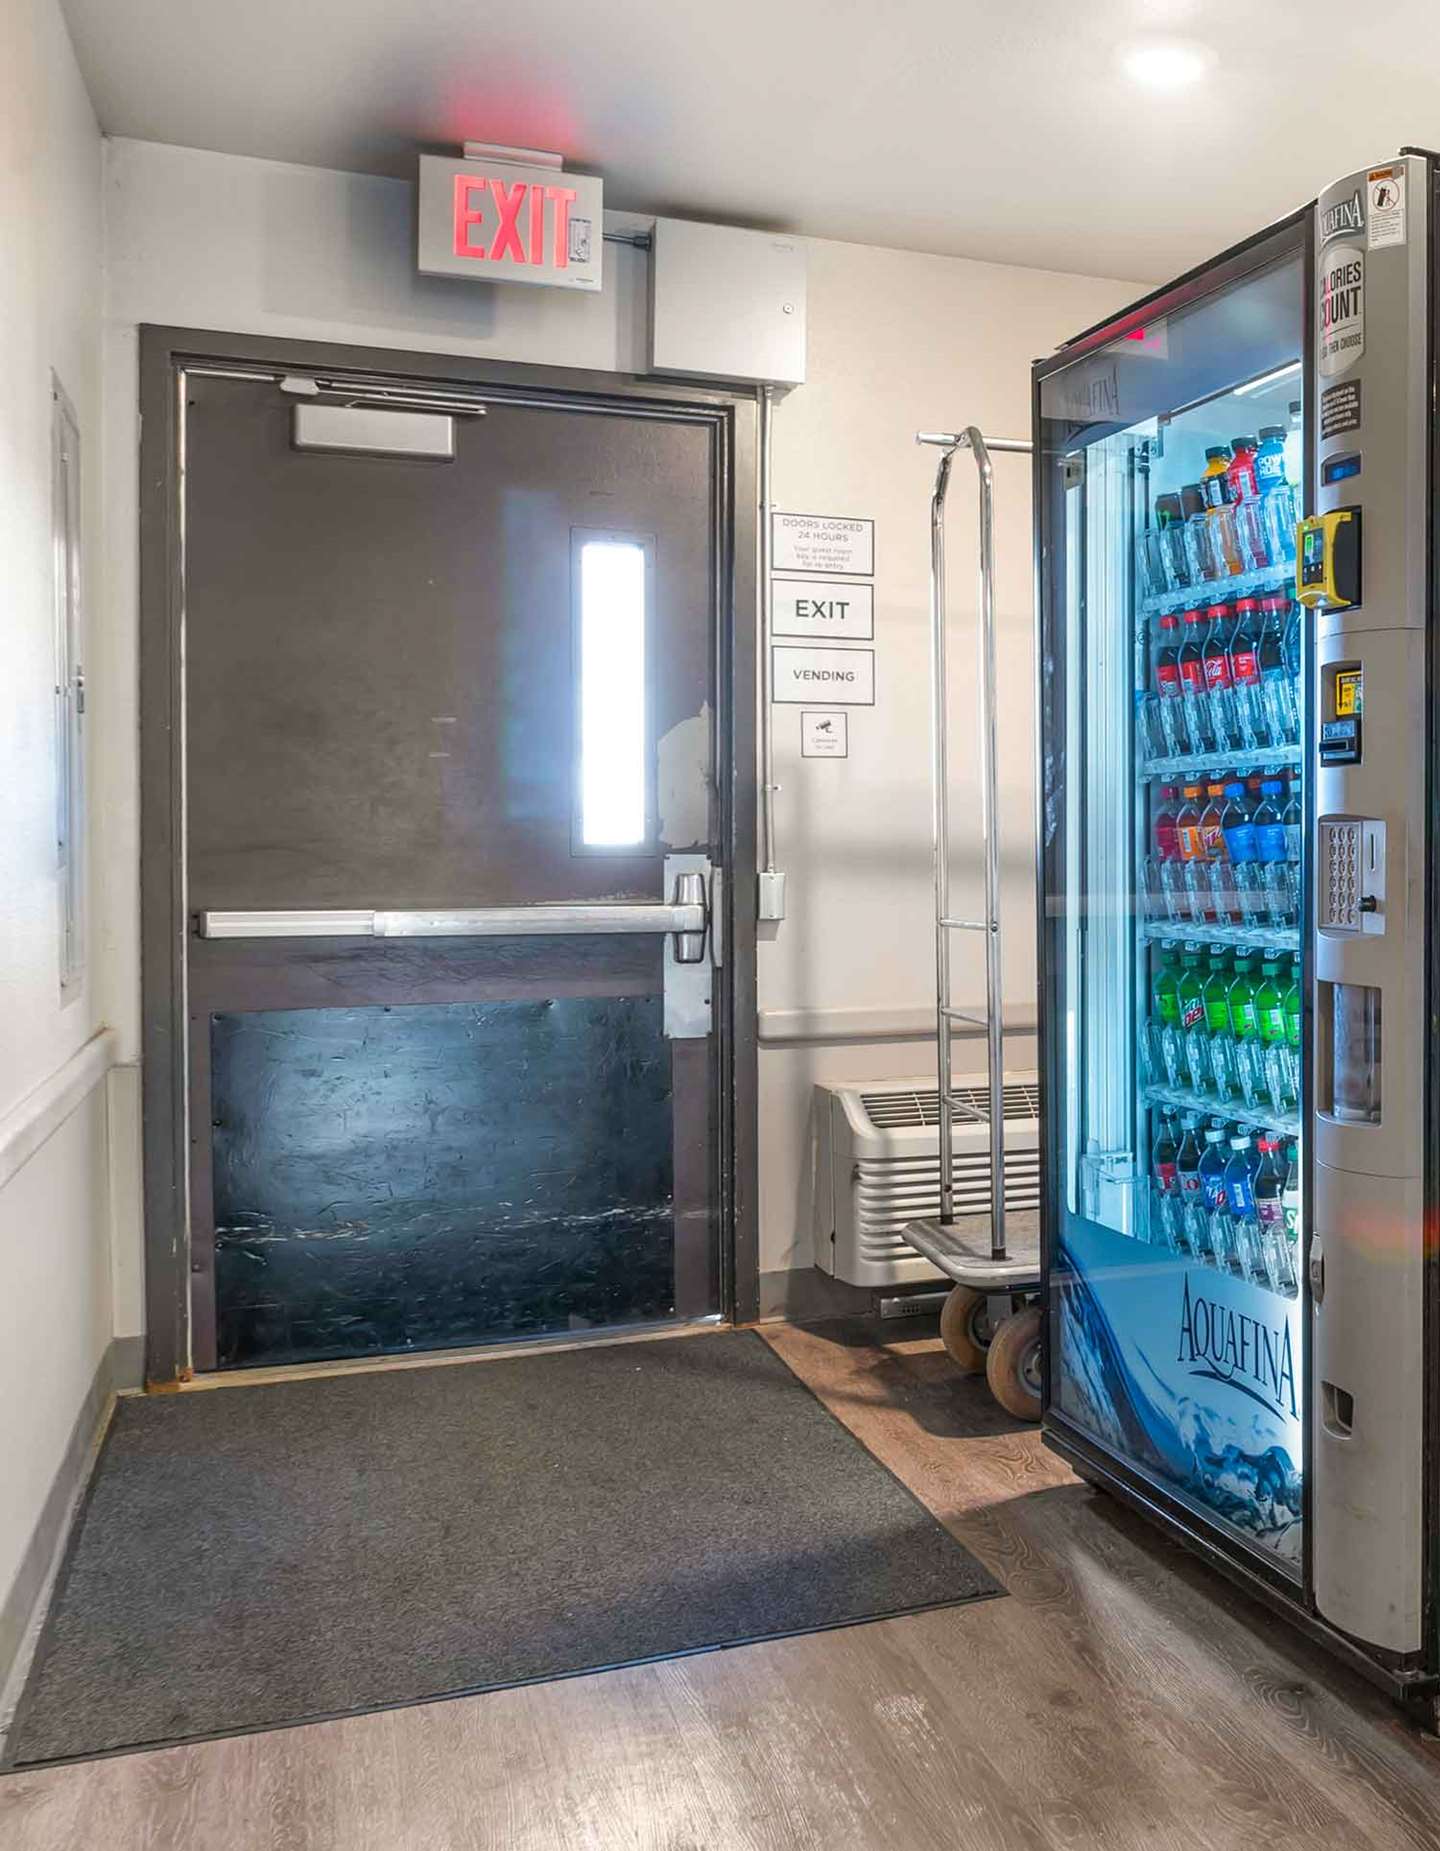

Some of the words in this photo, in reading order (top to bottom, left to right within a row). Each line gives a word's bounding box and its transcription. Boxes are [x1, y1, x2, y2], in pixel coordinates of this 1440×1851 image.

[454, 174, 577, 269] EXIT
[782, 518, 819, 529] DOORS
[822, 521, 864, 533] LOCKED
[797, 531, 811, 540] 24
[813, 531, 848, 543] HOURS
[795, 599, 850, 620] EXIT
[793, 669, 855, 682] VENDING
[1177, 1271, 1300, 1421] AQUAFINA
